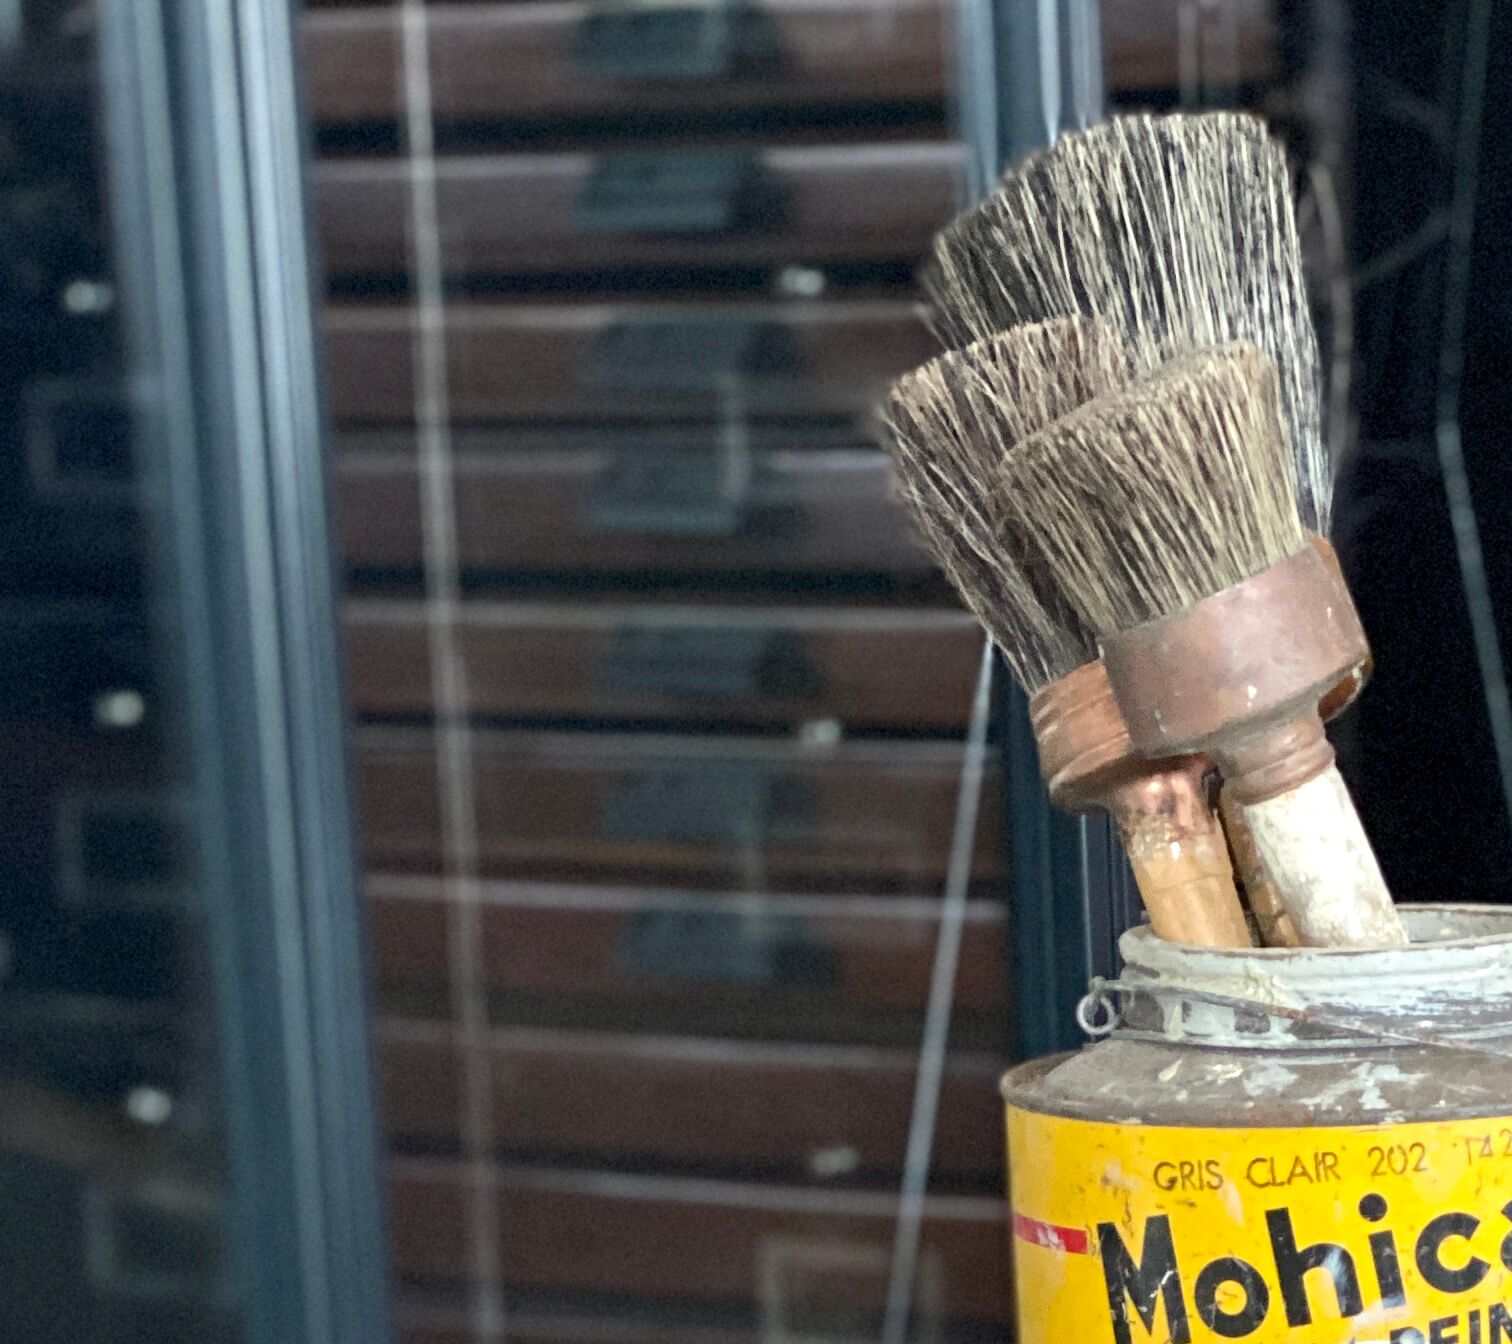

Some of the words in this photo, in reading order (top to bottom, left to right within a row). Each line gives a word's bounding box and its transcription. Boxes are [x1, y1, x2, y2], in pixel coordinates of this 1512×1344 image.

[1153, 1159, 1224, 1191] GRIS
[1246, 1151, 1341, 1188] CLAIR
[1367, 1142, 1428, 1176] 202
